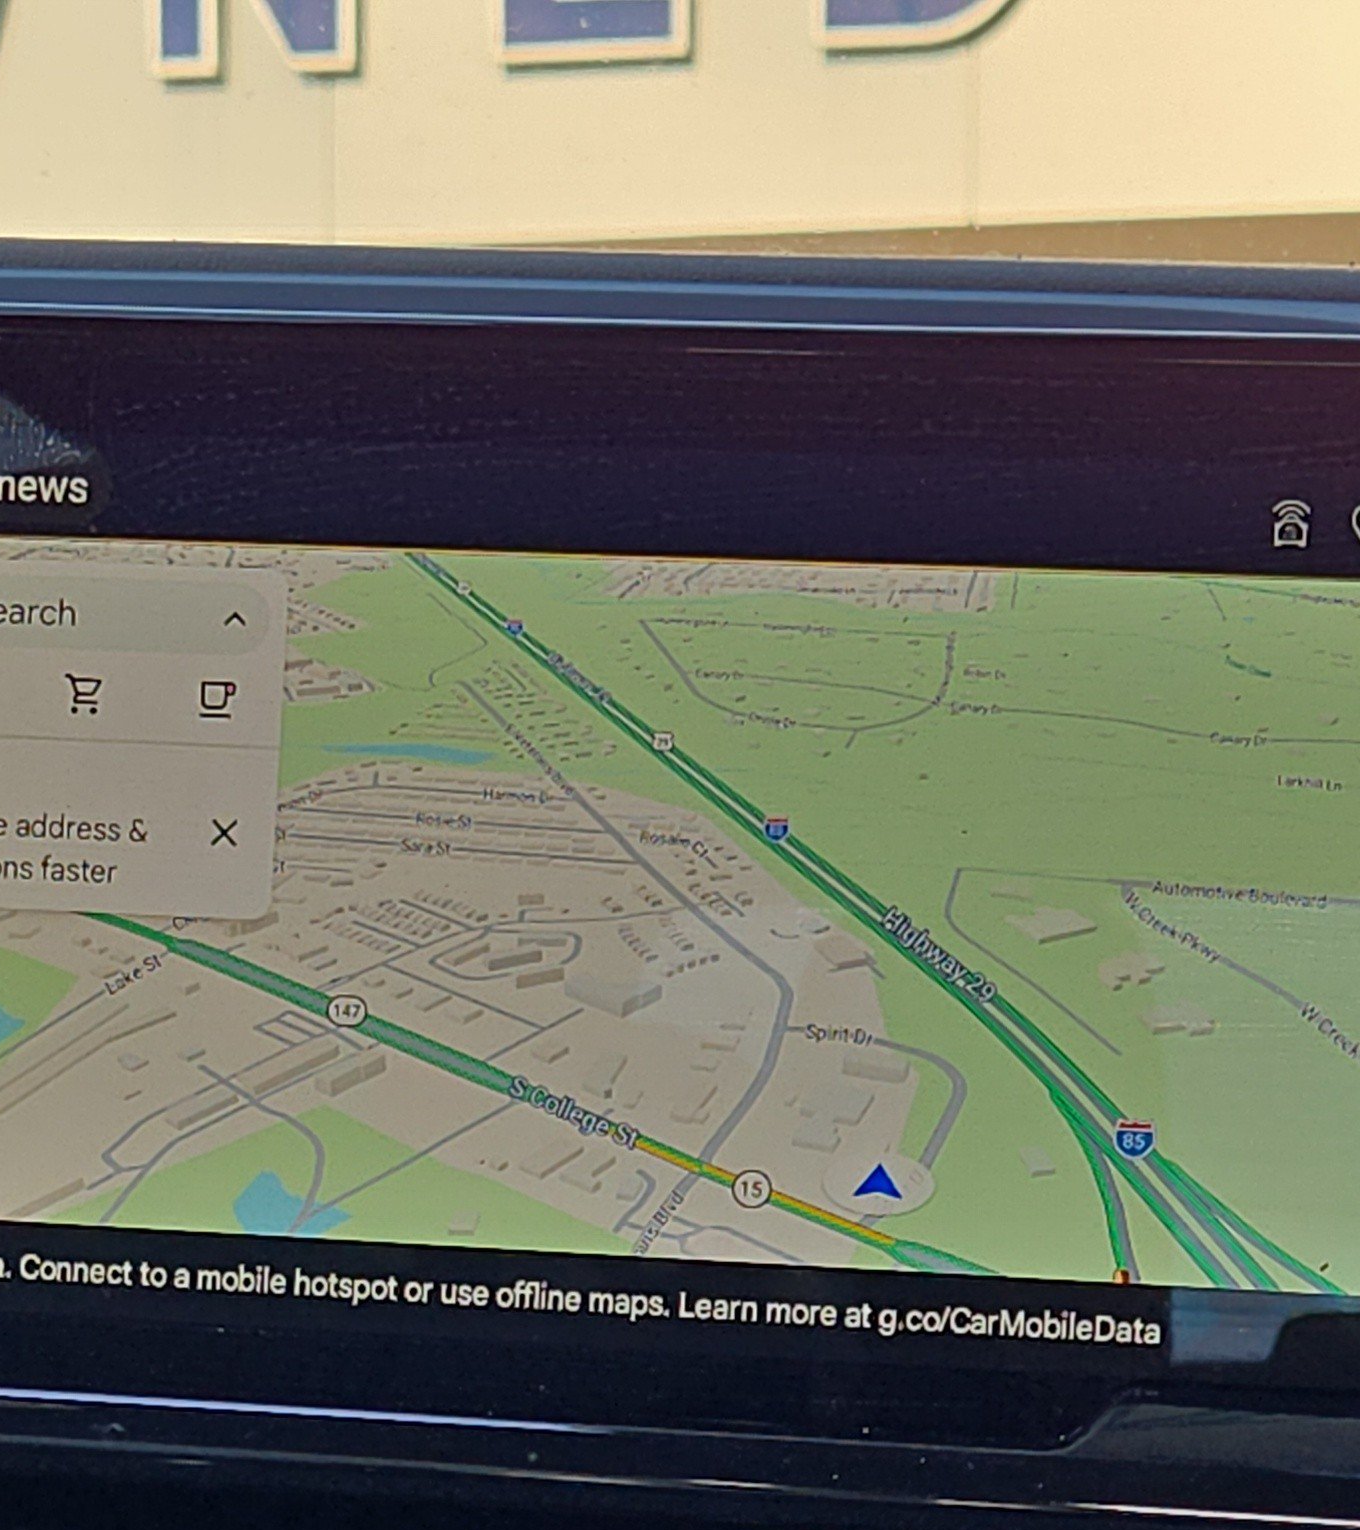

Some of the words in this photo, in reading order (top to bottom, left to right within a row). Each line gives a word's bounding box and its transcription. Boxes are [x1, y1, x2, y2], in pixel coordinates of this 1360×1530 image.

[16, 813, 121, 841] address
[129, 819, 147, 842] &
[41, 854, 117, 883] faster
[1152, 880, 1244, 902] Automotive
[1247, 888, 1327, 910] Boulevard
[1138, 905, 1178, 940] Creek
[1180, 931, 1221, 963] Pkwy
[883, 904, 968, 982] Highway
[964, 972, 997, 1003] 29
[104, 967, 144, 995] Lake
[143, 953, 163, 974] St
[334, 1002, 362, 1019] 147
[1300, 1001, 1320, 1024] W
[1317, 1017, 1359, 1059] Creek
[509, 1076, 529, 1098] S
[530, 1084, 609, 1135] College
[613, 1122, 639, 1149] St
[1122, 1132, 1146, 1151] 85
[741, 1181, 762, 1198] 15
[652, 1190, 684, 1226] Blvd
[19, 1253, 132, 1287] Connect
[140, 1261, 166, 1289] to
[174, 1267, 190, 1290] a
[196, 1264, 287, 1295] mobile
[293, 1267, 398, 1306] hotspot
[404, 1280, 433, 1303] or
[441, 1283, 489, 1307] use
[495, 1279, 581, 1313] offline
[589, 1290, 670, 1322] maps.
[678, 1291, 757, 1325] Learn
[766, 1302, 837, 1328] more
[844, 1300, 872, 1329] at
[878, 1305, 1161, 1346] g.co/CarMobileData
